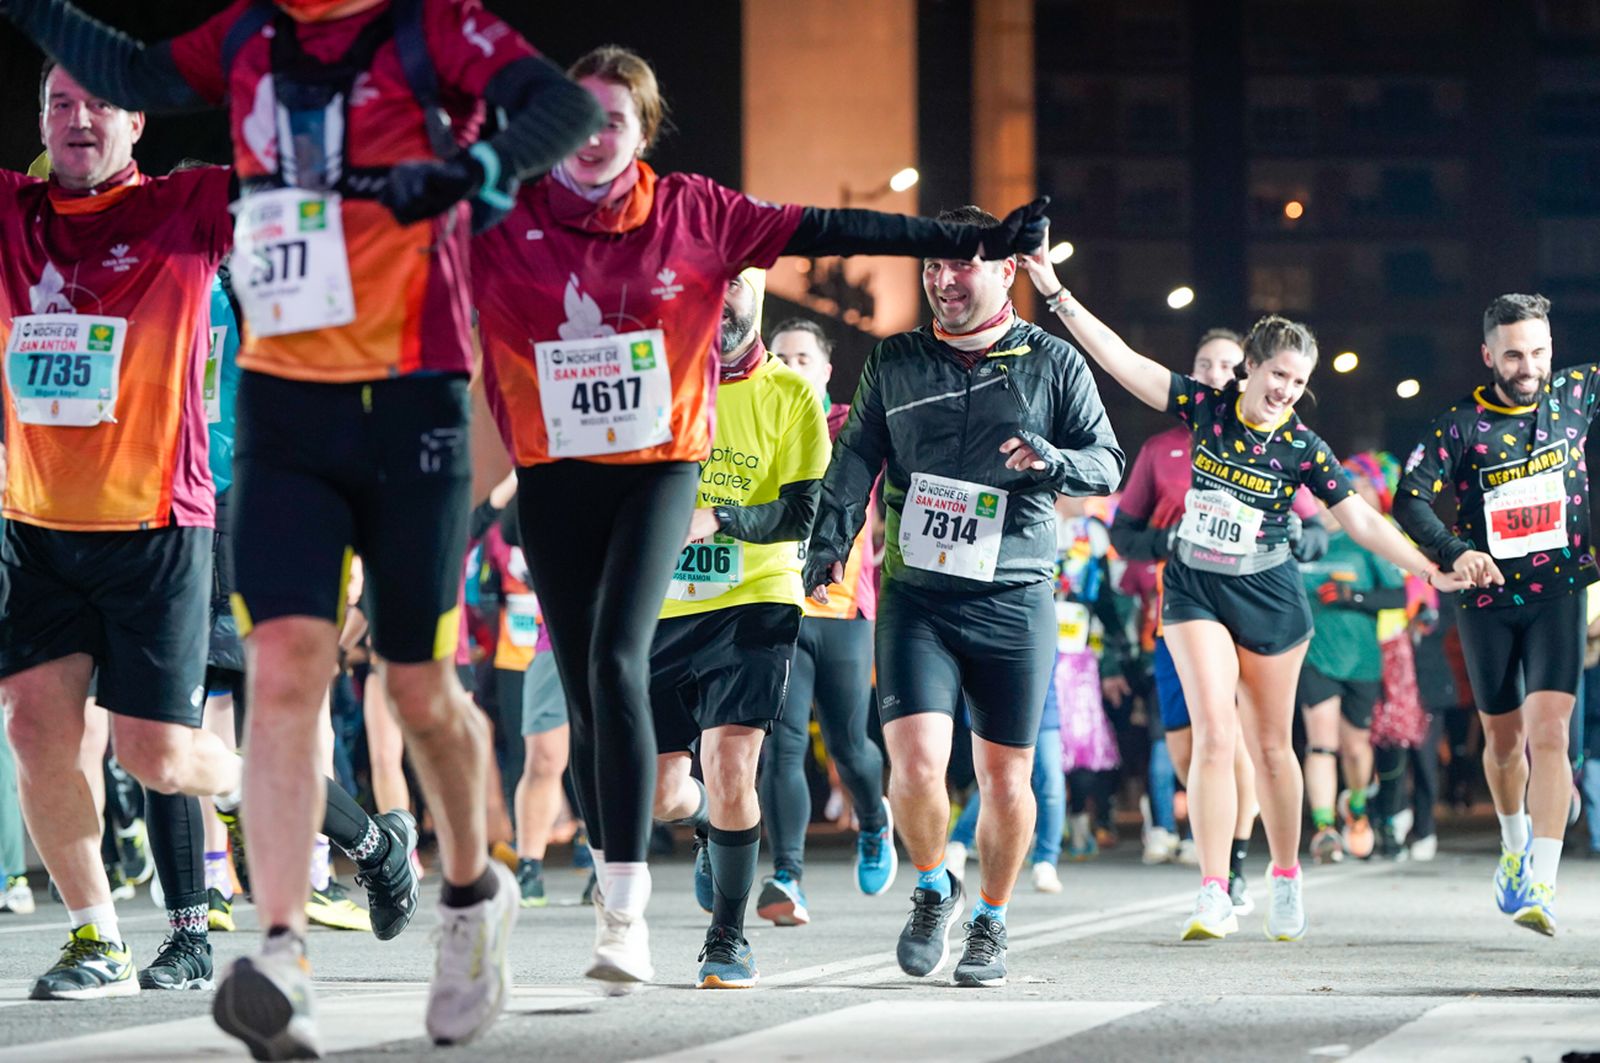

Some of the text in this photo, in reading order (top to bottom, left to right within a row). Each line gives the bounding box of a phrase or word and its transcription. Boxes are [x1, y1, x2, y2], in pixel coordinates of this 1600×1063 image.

[33, 327, 77, 337] NOCHE DE
[20, 341, 38, 352] SAN
[566, 351, 618, 364] NOCHE DE
[27, 354, 91, 387] 7735
[554, 368, 577, 381] SAN
[571, 376, 642, 415] 4617
[710, 446, 759, 469] ptica
[1487, 449, 1564, 486] BESTIA PARDA
[702, 472, 752, 491] uarez
[1231, 470, 1272, 493] PARDA
[916, 495, 933, 507] SAN
[934, 499, 967, 513] ANTÓN
[928, 486, 956, 499] NOCHE
[956, 491, 969, 502] DE
[922, 509, 978, 545] 7314
[1196, 512, 1242, 543] 5409
[675, 545, 731, 573] 206
